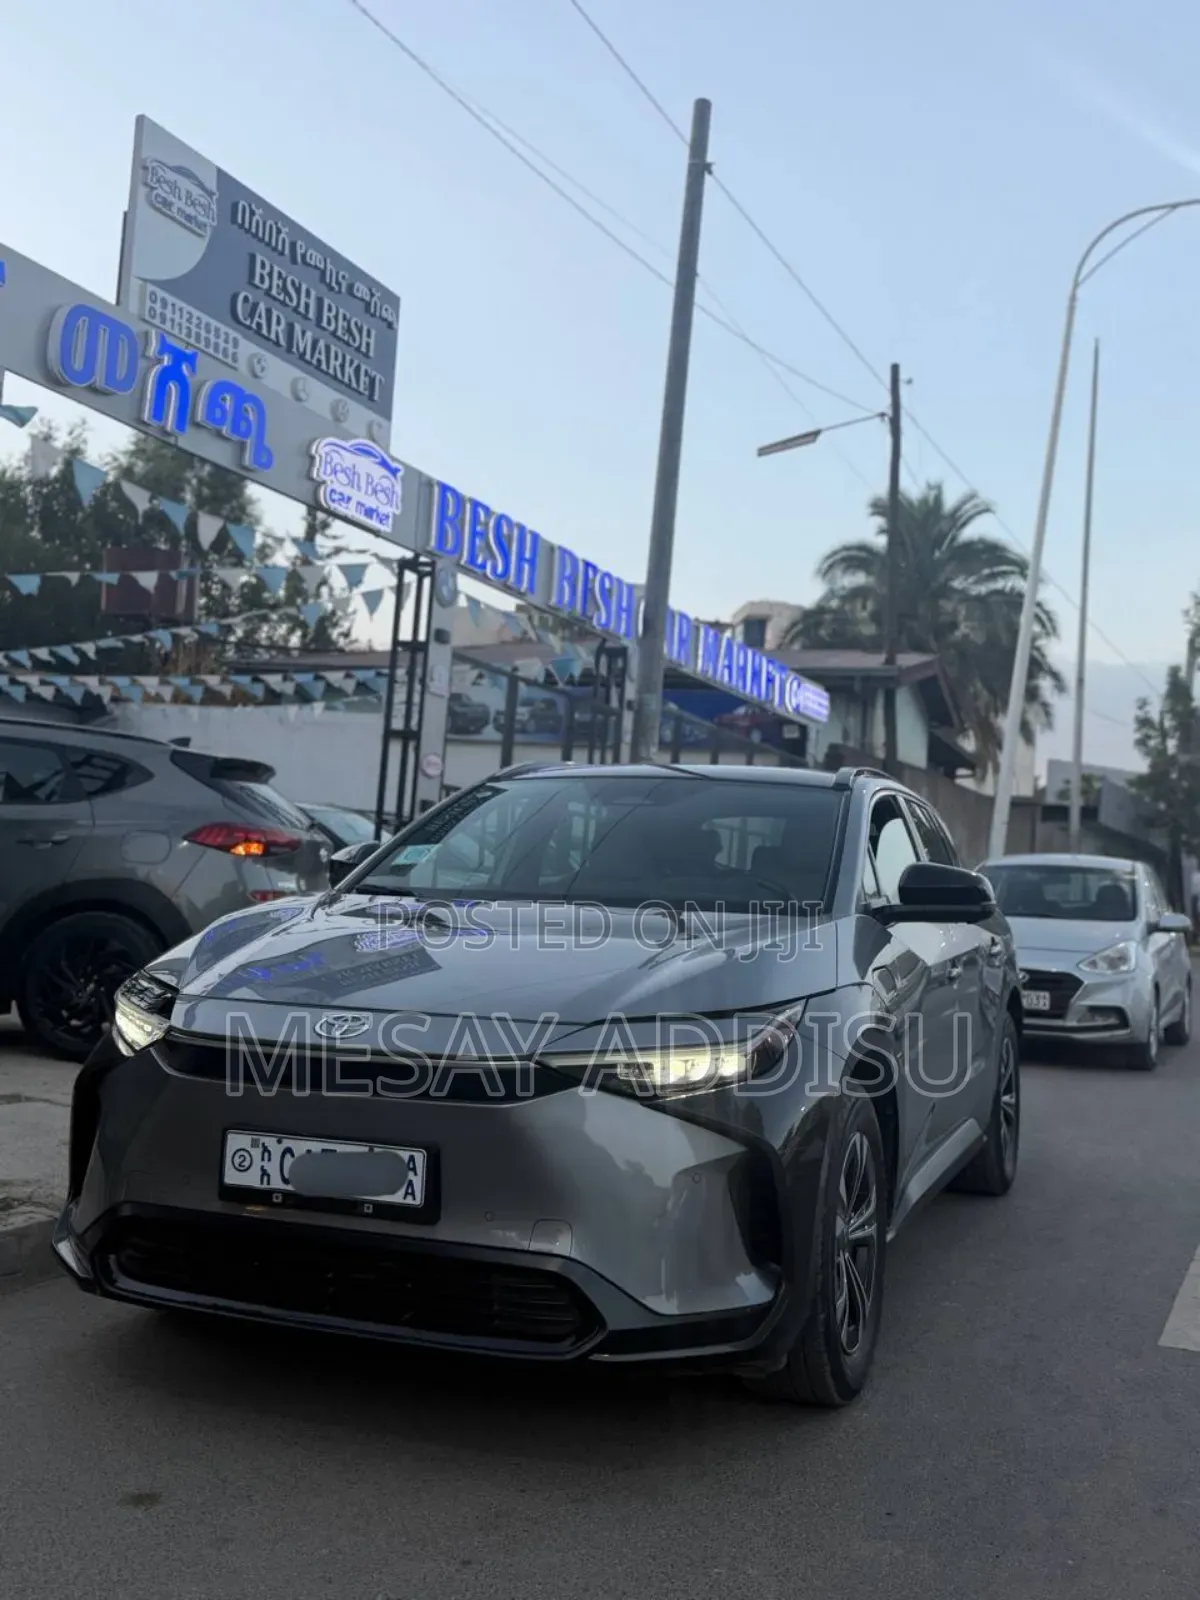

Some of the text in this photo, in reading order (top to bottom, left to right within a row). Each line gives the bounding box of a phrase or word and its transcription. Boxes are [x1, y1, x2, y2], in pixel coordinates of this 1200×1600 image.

[236, 291, 386, 402] CAR MARKET
[253, 252, 377, 358] BESH BESH
[322, 449, 400, 510] Besh Besh
[328, 487, 392, 528] car market
[433, 481, 541, 595] BESH
[553, 545, 635, 640] BESH
[698, 623, 789, 708] MARKET
